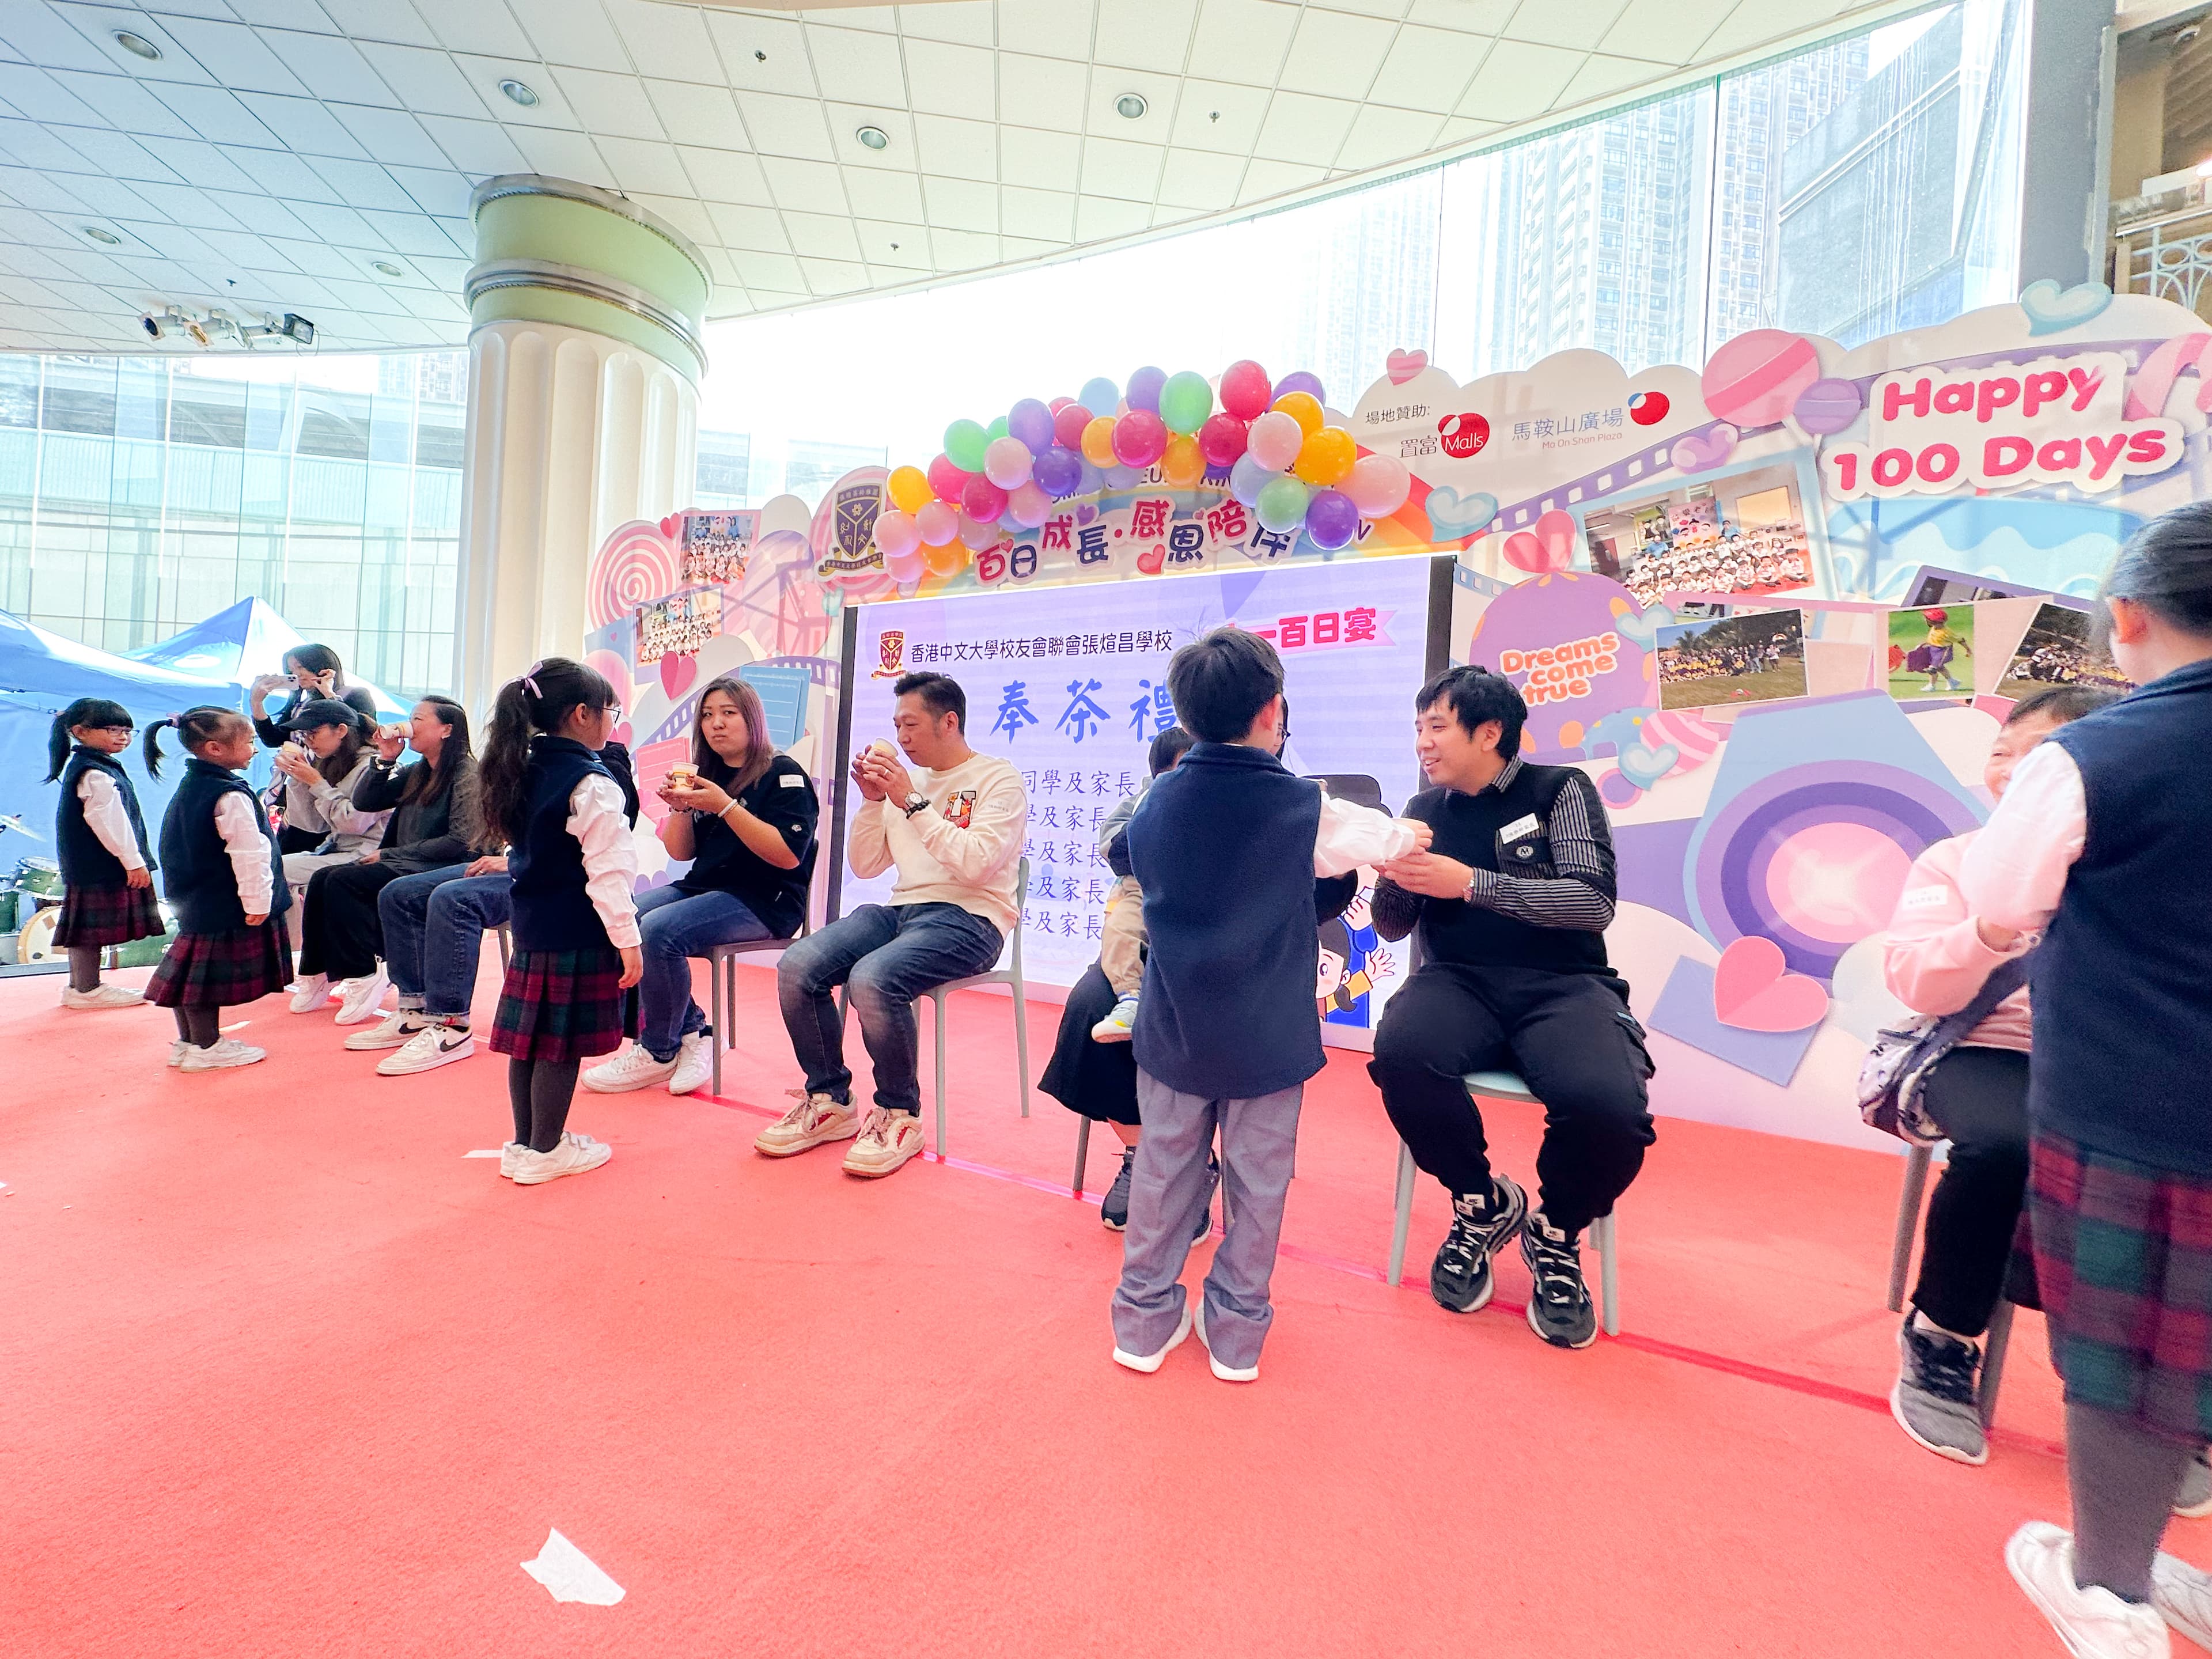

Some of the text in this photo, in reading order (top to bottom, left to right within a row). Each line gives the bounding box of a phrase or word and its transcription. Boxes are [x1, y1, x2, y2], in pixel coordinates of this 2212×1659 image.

[1883, 365, 2105, 423] Happy
[1512, 408, 1624, 441] 馬鞍山廣場
[1399, 435, 1437, 458] 置富
[1445, 433, 1483, 452] Malls
[1542, 432, 1622, 450] Ma On Shan Plaza
[1834, 430, 2166, 491] 100 Days
[911, 630, 1173, 663] 香港中文大學校友會聯會張煊昌學校
[1502, 634, 1617, 673] Dreams
[1530, 654, 1614, 685] come
[1522, 679, 1588, 704] true
[990, 678, 1177, 744] 奉茶禮
[1021, 769, 1135, 797] 同學及家長
[1027, 876, 1105, 904] 及家長
